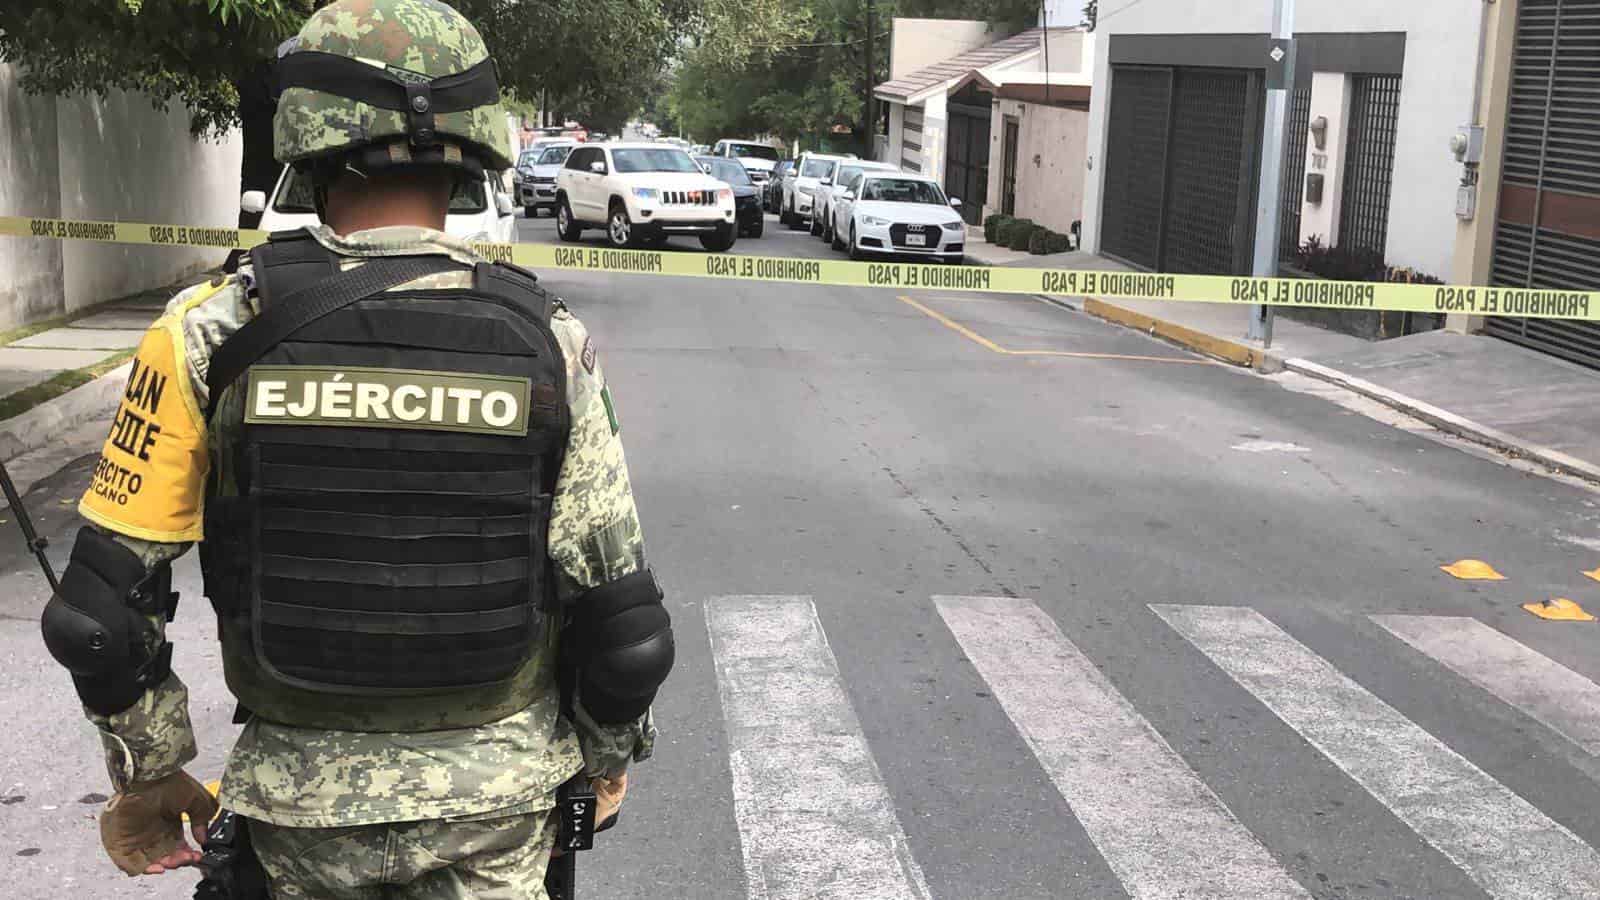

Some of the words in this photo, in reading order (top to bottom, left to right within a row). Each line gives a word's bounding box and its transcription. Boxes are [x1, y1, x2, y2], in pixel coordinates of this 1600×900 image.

[126, 356, 168, 415] LAN
[255, 373, 518, 427] EJÉRCITO
[95, 456, 142, 494] RCITO
